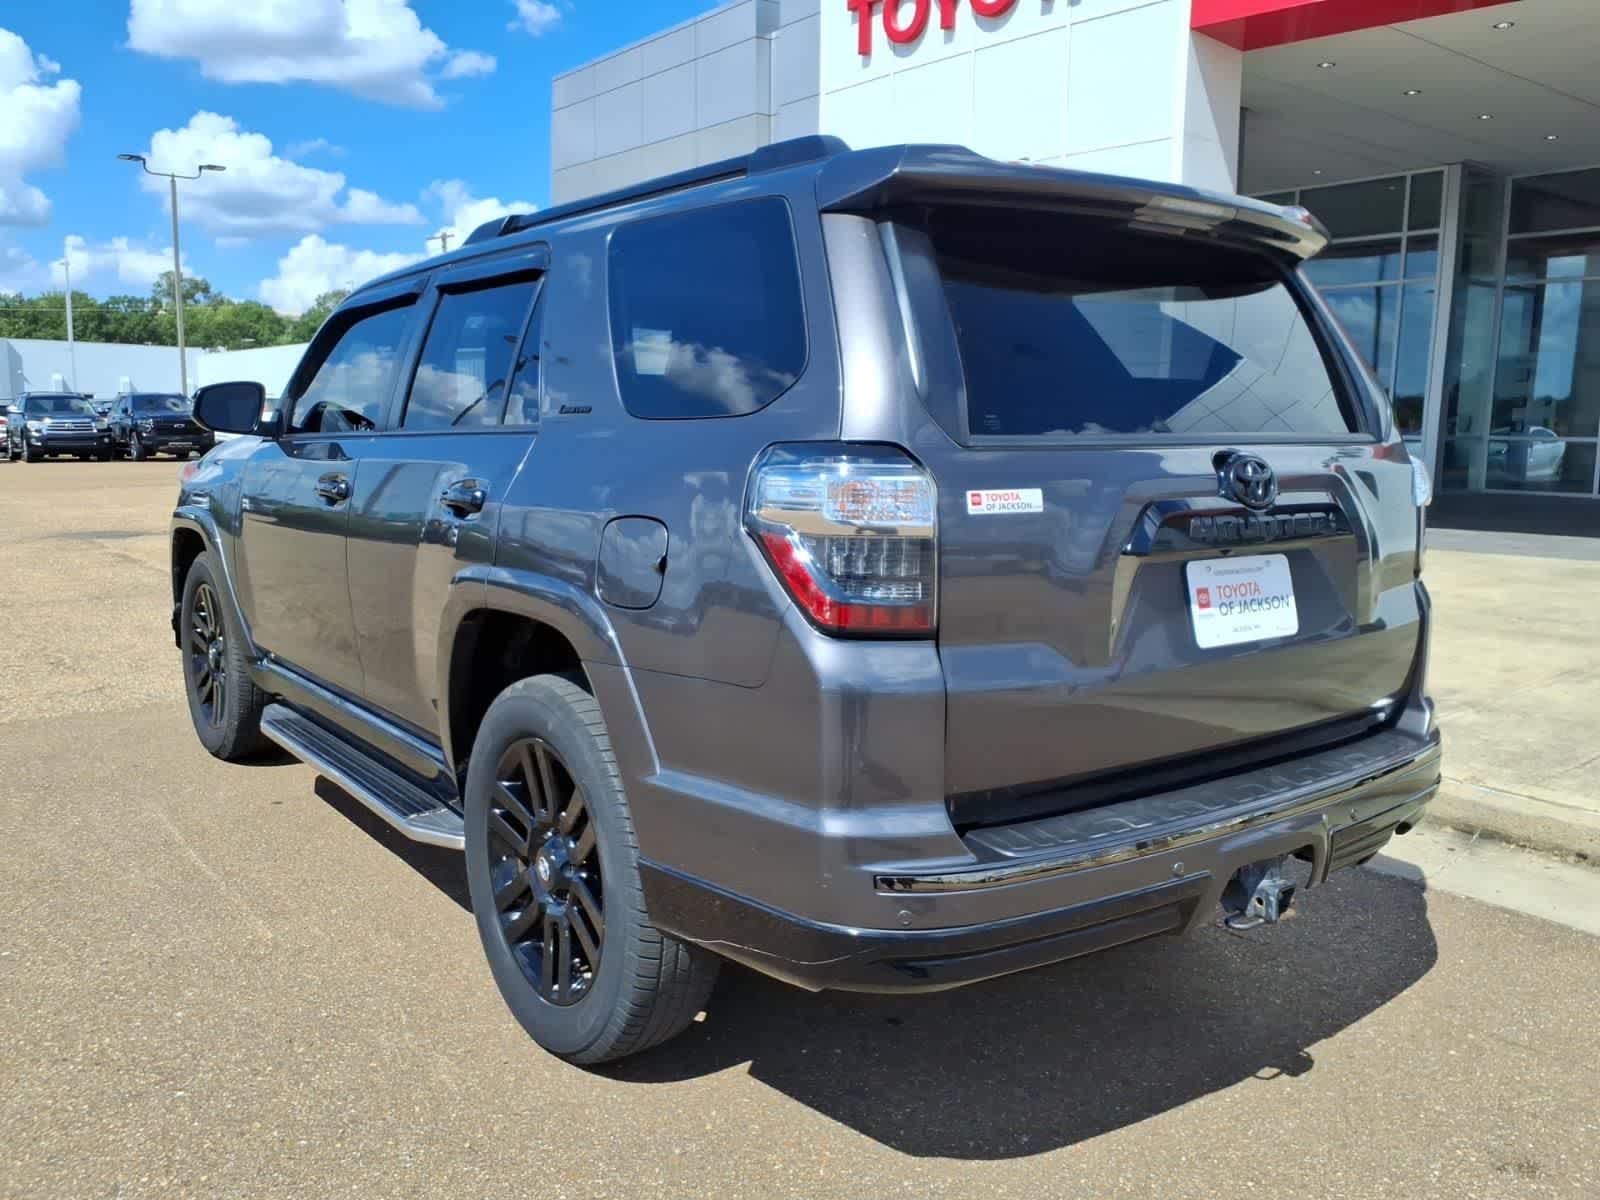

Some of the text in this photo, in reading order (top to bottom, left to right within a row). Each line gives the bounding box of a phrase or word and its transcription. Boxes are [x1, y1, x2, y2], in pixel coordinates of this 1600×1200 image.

[985, 492, 1021, 502] TOYOTA
[986, 503, 995, 511] OF
[999, 502, 1032, 510] JACKSON
[1216, 582, 1261, 600] TOYOTA
[1218, 595, 1290, 616] OF JACKSON
